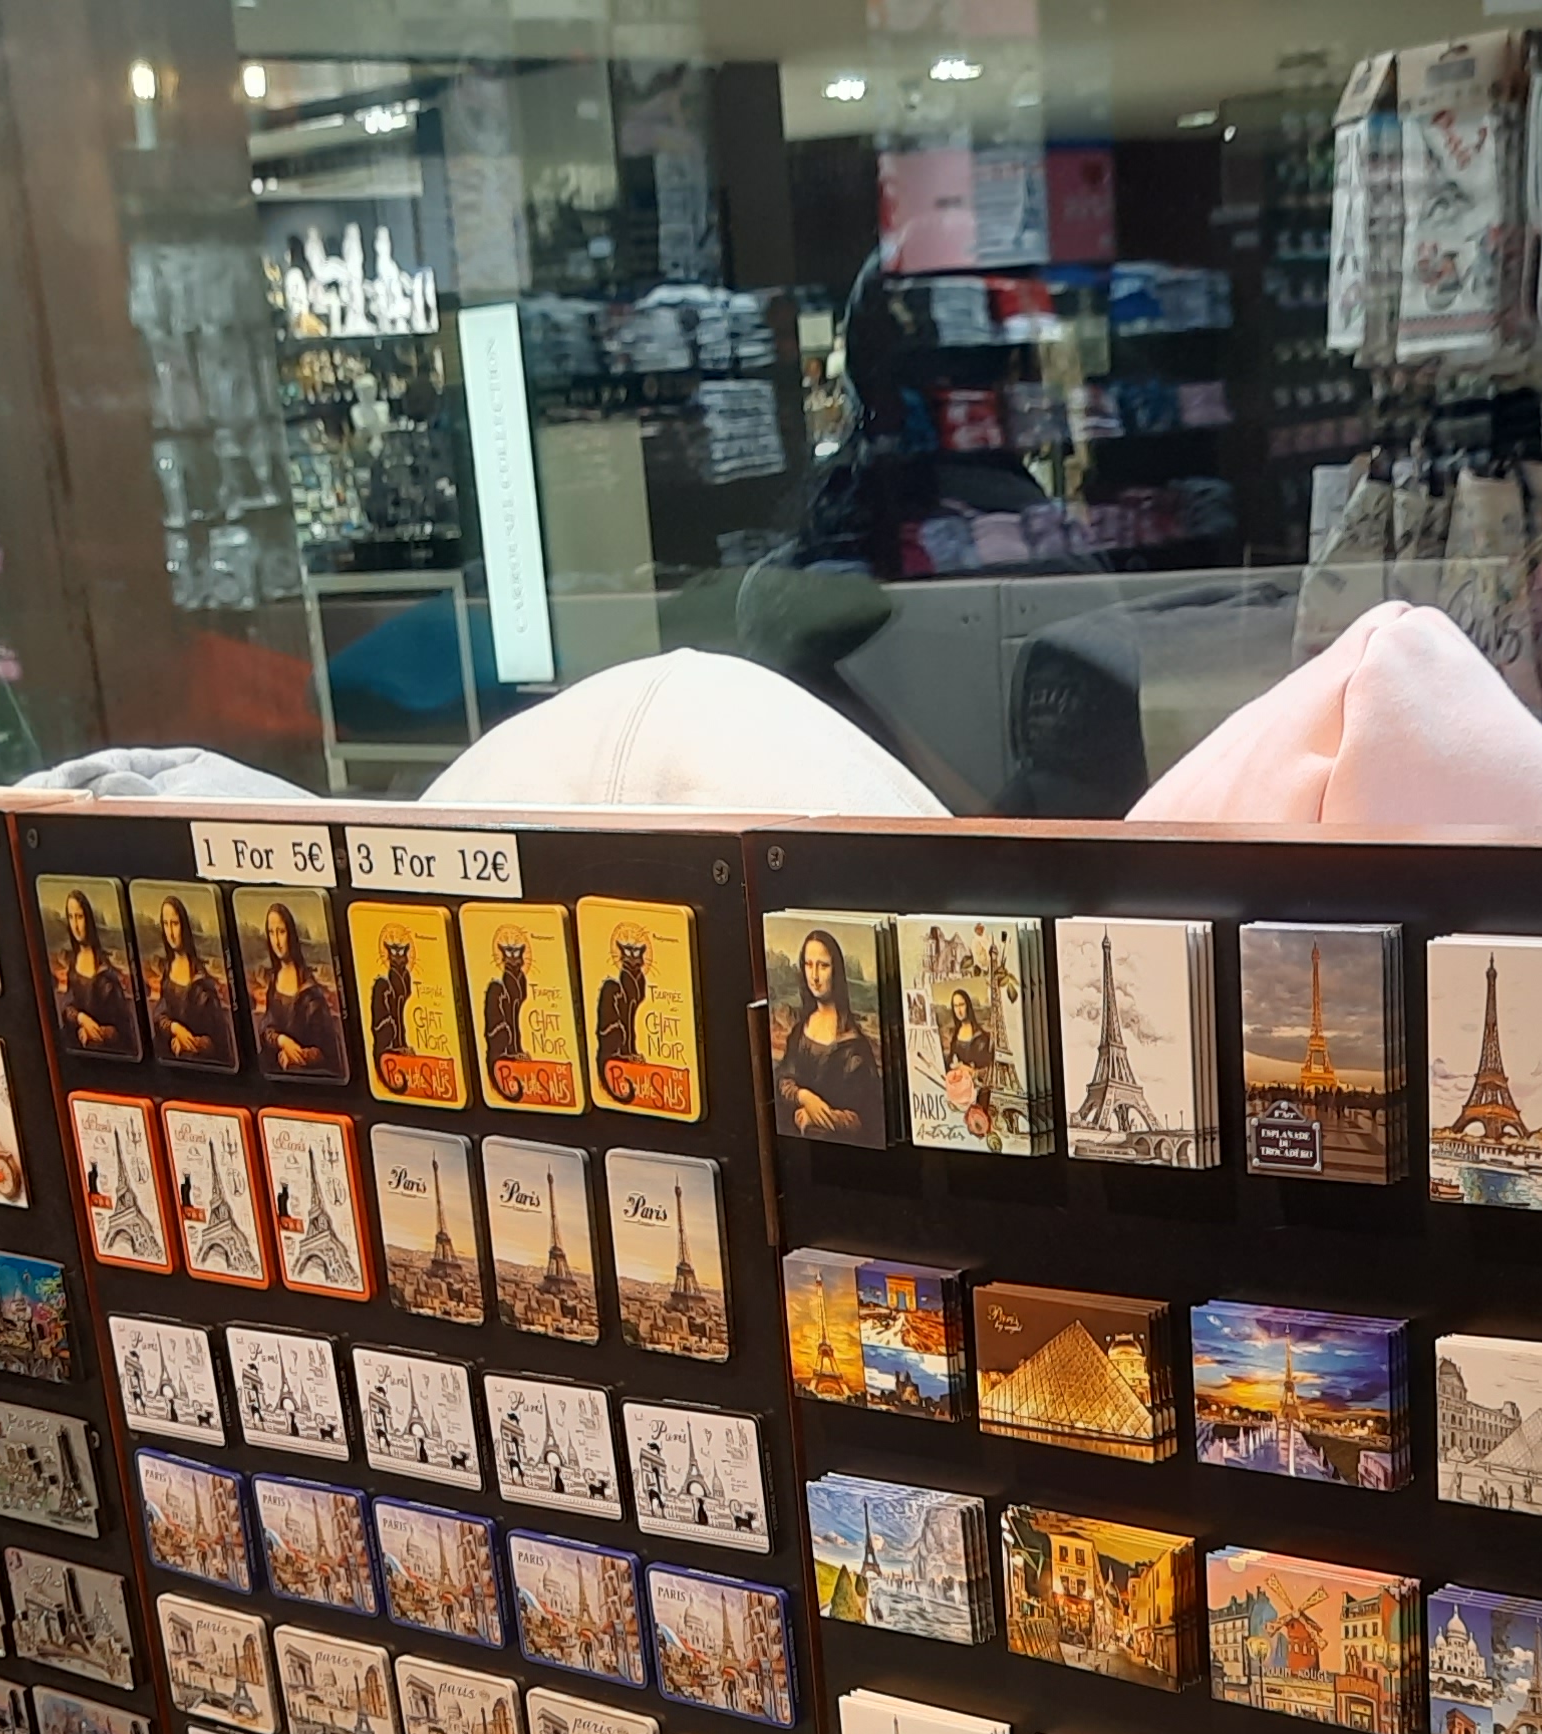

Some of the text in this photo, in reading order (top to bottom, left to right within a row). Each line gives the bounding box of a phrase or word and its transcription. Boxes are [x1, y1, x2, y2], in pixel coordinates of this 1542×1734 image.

[203, 838, 326, 873] 1 For 5€
[357, 843, 510, 883] 3 For 12€
[413, 1006, 443, 1033] CHAT
[529, 1010, 561, 1036] CHAT
[645, 1012, 681, 1041] CHAT
[416, 1028, 451, 1055] NOIR
[532, 1032, 569, 1059] NOIR
[648, 1034, 687, 1065] NOIR
[913, 1092, 947, 1121] PARIS
[388, 1165, 428, 1194] Paris
[499, 1178, 541, 1208] Paris
[623, 1191, 669, 1222] Paris
[376, 1364, 408, 1388] Paris
[509, 1391, 544, 1415] Paris
[650, 1418, 688, 1444] Paris
[145, 1469, 167, 1483] PARIS
[262, 1493, 286, 1508] PARIS
[382, 1516, 409, 1532] PARIS
[517, 1550, 545, 1567] PARIS
[657, 1584, 686, 1602] PARIS
[195, 1618, 229, 1635] paris
[315, 1651, 352, 1668] paris
[438, 1681, 478, 1700] paris
